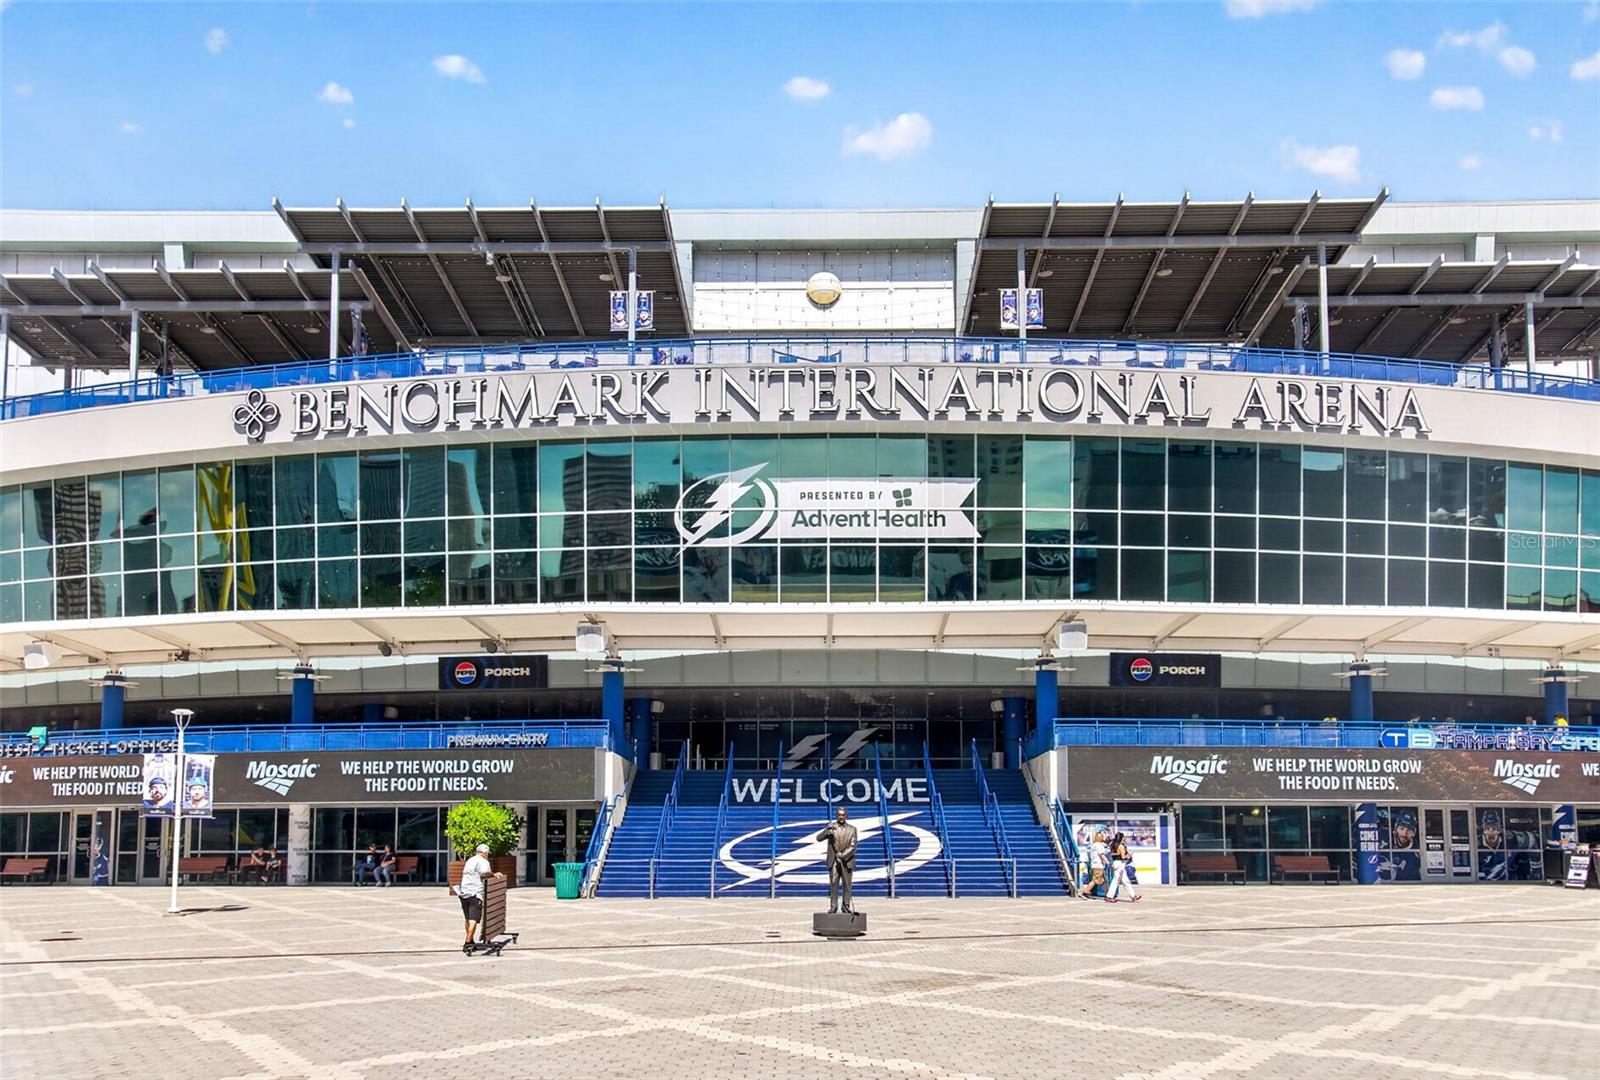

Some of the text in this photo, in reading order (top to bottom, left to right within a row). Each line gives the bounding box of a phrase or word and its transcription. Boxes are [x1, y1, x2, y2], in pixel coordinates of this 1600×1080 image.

[291, 366, 1433, 436] BENCHMARK INTERNATIONAL ARENA
[800, 491, 883, 500] PRESENTED BY
[791, 509, 946, 528] AdventHealth
[484, 667, 531, 677] PORCH
[1159, 665, 1206, 675] PORCH
[52, 741, 110, 756] TICKET
[116, 738, 178, 753] OFFICE
[447, 732, 549, 747] PREMIUM ENTRY
[1441, 732, 1509, 750] TAMPA
[1516, 733, 1556, 751] BAY
[33, 765, 140, 780] WE HELP THE WORLD
[246, 758, 317, 779] Mosaic
[341, 759, 514, 775] WE HELP THE WORLD GROW
[1150, 754, 1228, 775] Mosaic
[1252, 758, 1422, 774] WE HELP THE WORLD GROW
[1493, 758, 1561, 778] Mosaic
[1581, 763, 1600, 777] WE
[52, 783, 72, 797] THE
[73, 782, 103, 796] FOOD
[104, 782, 116, 795] IT
[364, 777, 488, 792] THE FOOD IT NEEDS.
[732, 778, 930, 803] WELCOME
[1278, 775, 1400, 791] THE FOOD IT NEEDS.
